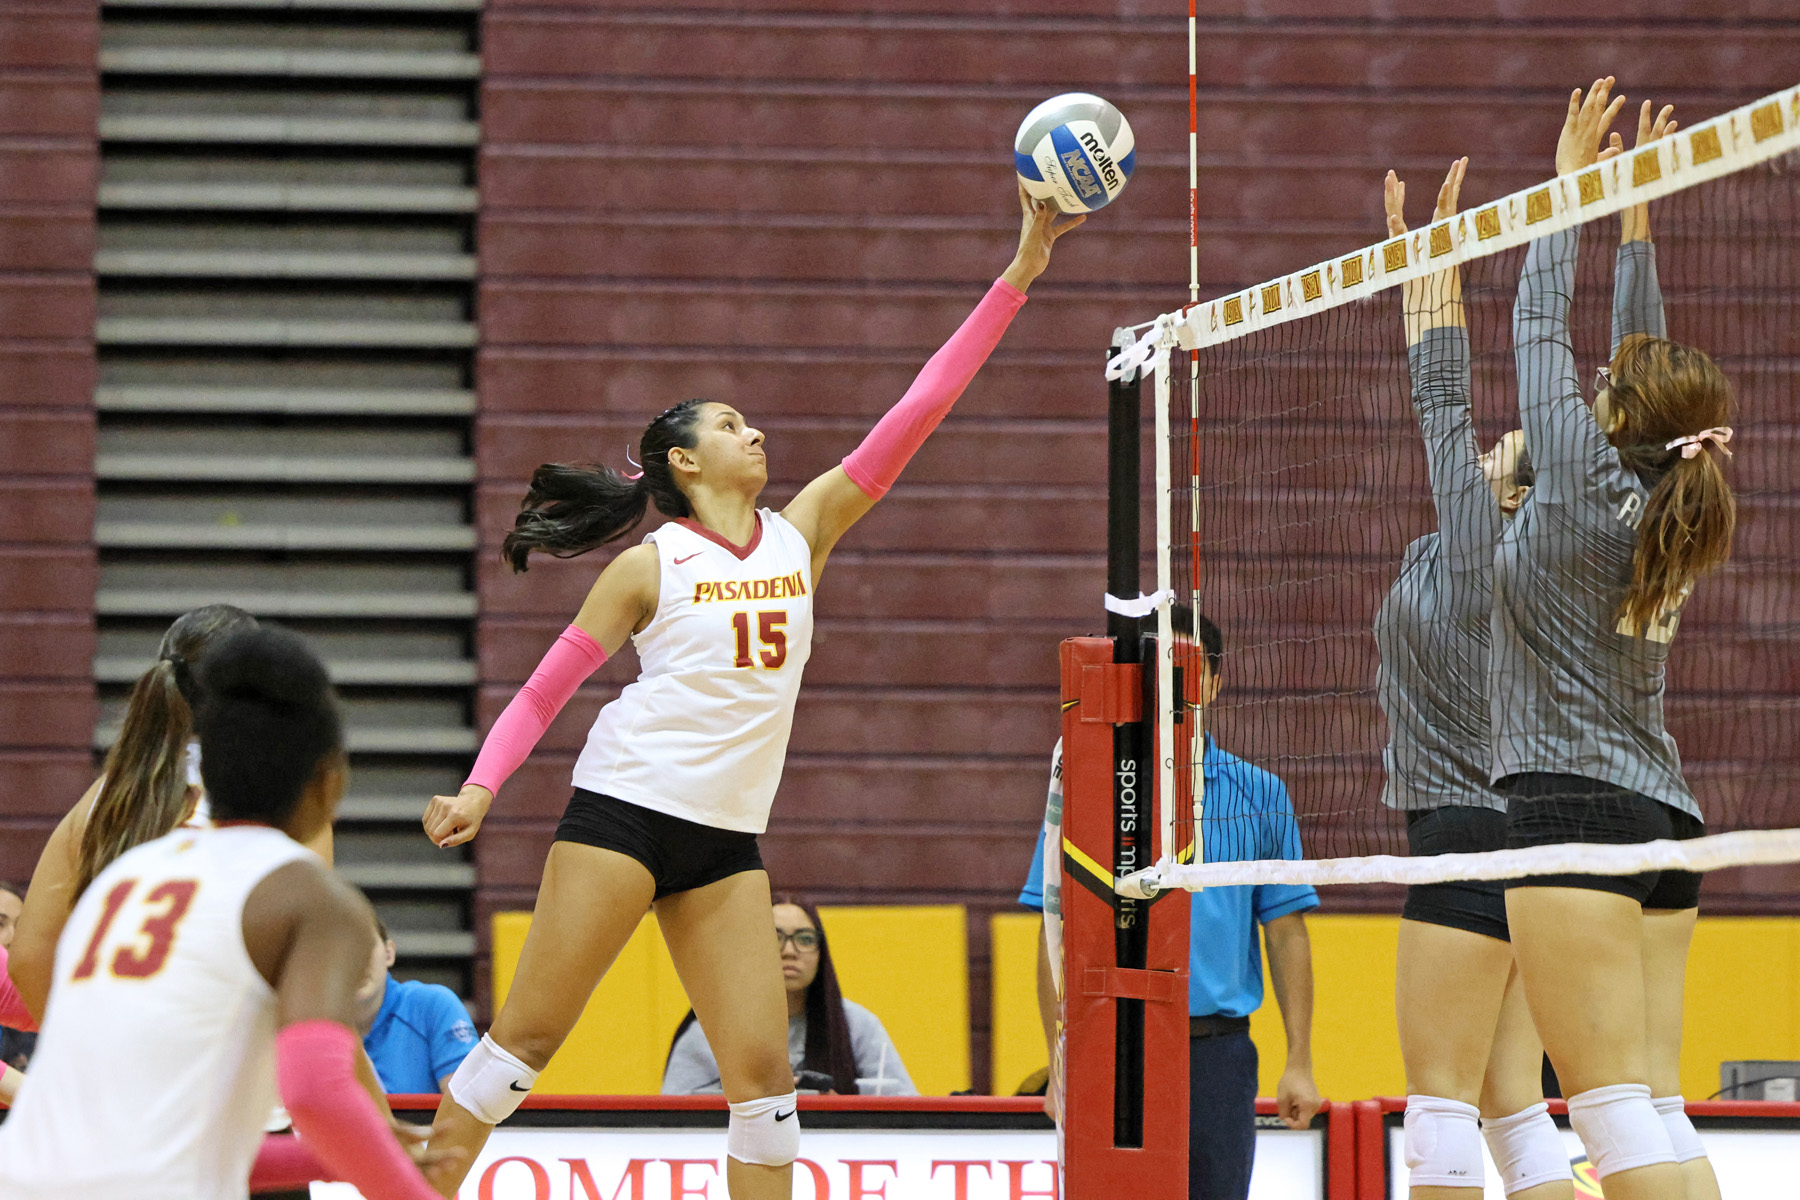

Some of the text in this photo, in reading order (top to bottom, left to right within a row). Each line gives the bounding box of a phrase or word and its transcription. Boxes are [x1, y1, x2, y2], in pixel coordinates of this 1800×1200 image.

[1060, 149, 1101, 198] NCAA
[1080, 132, 1119, 191] molten
[691, 569, 808, 605] PASADENA
[730, 610, 788, 670] 15
[1116, 759, 1138, 832] sports
[70, 878, 202, 983] 13
[454, 1156, 719, 1200] OME
[930, 1159, 1058, 1200] TH
